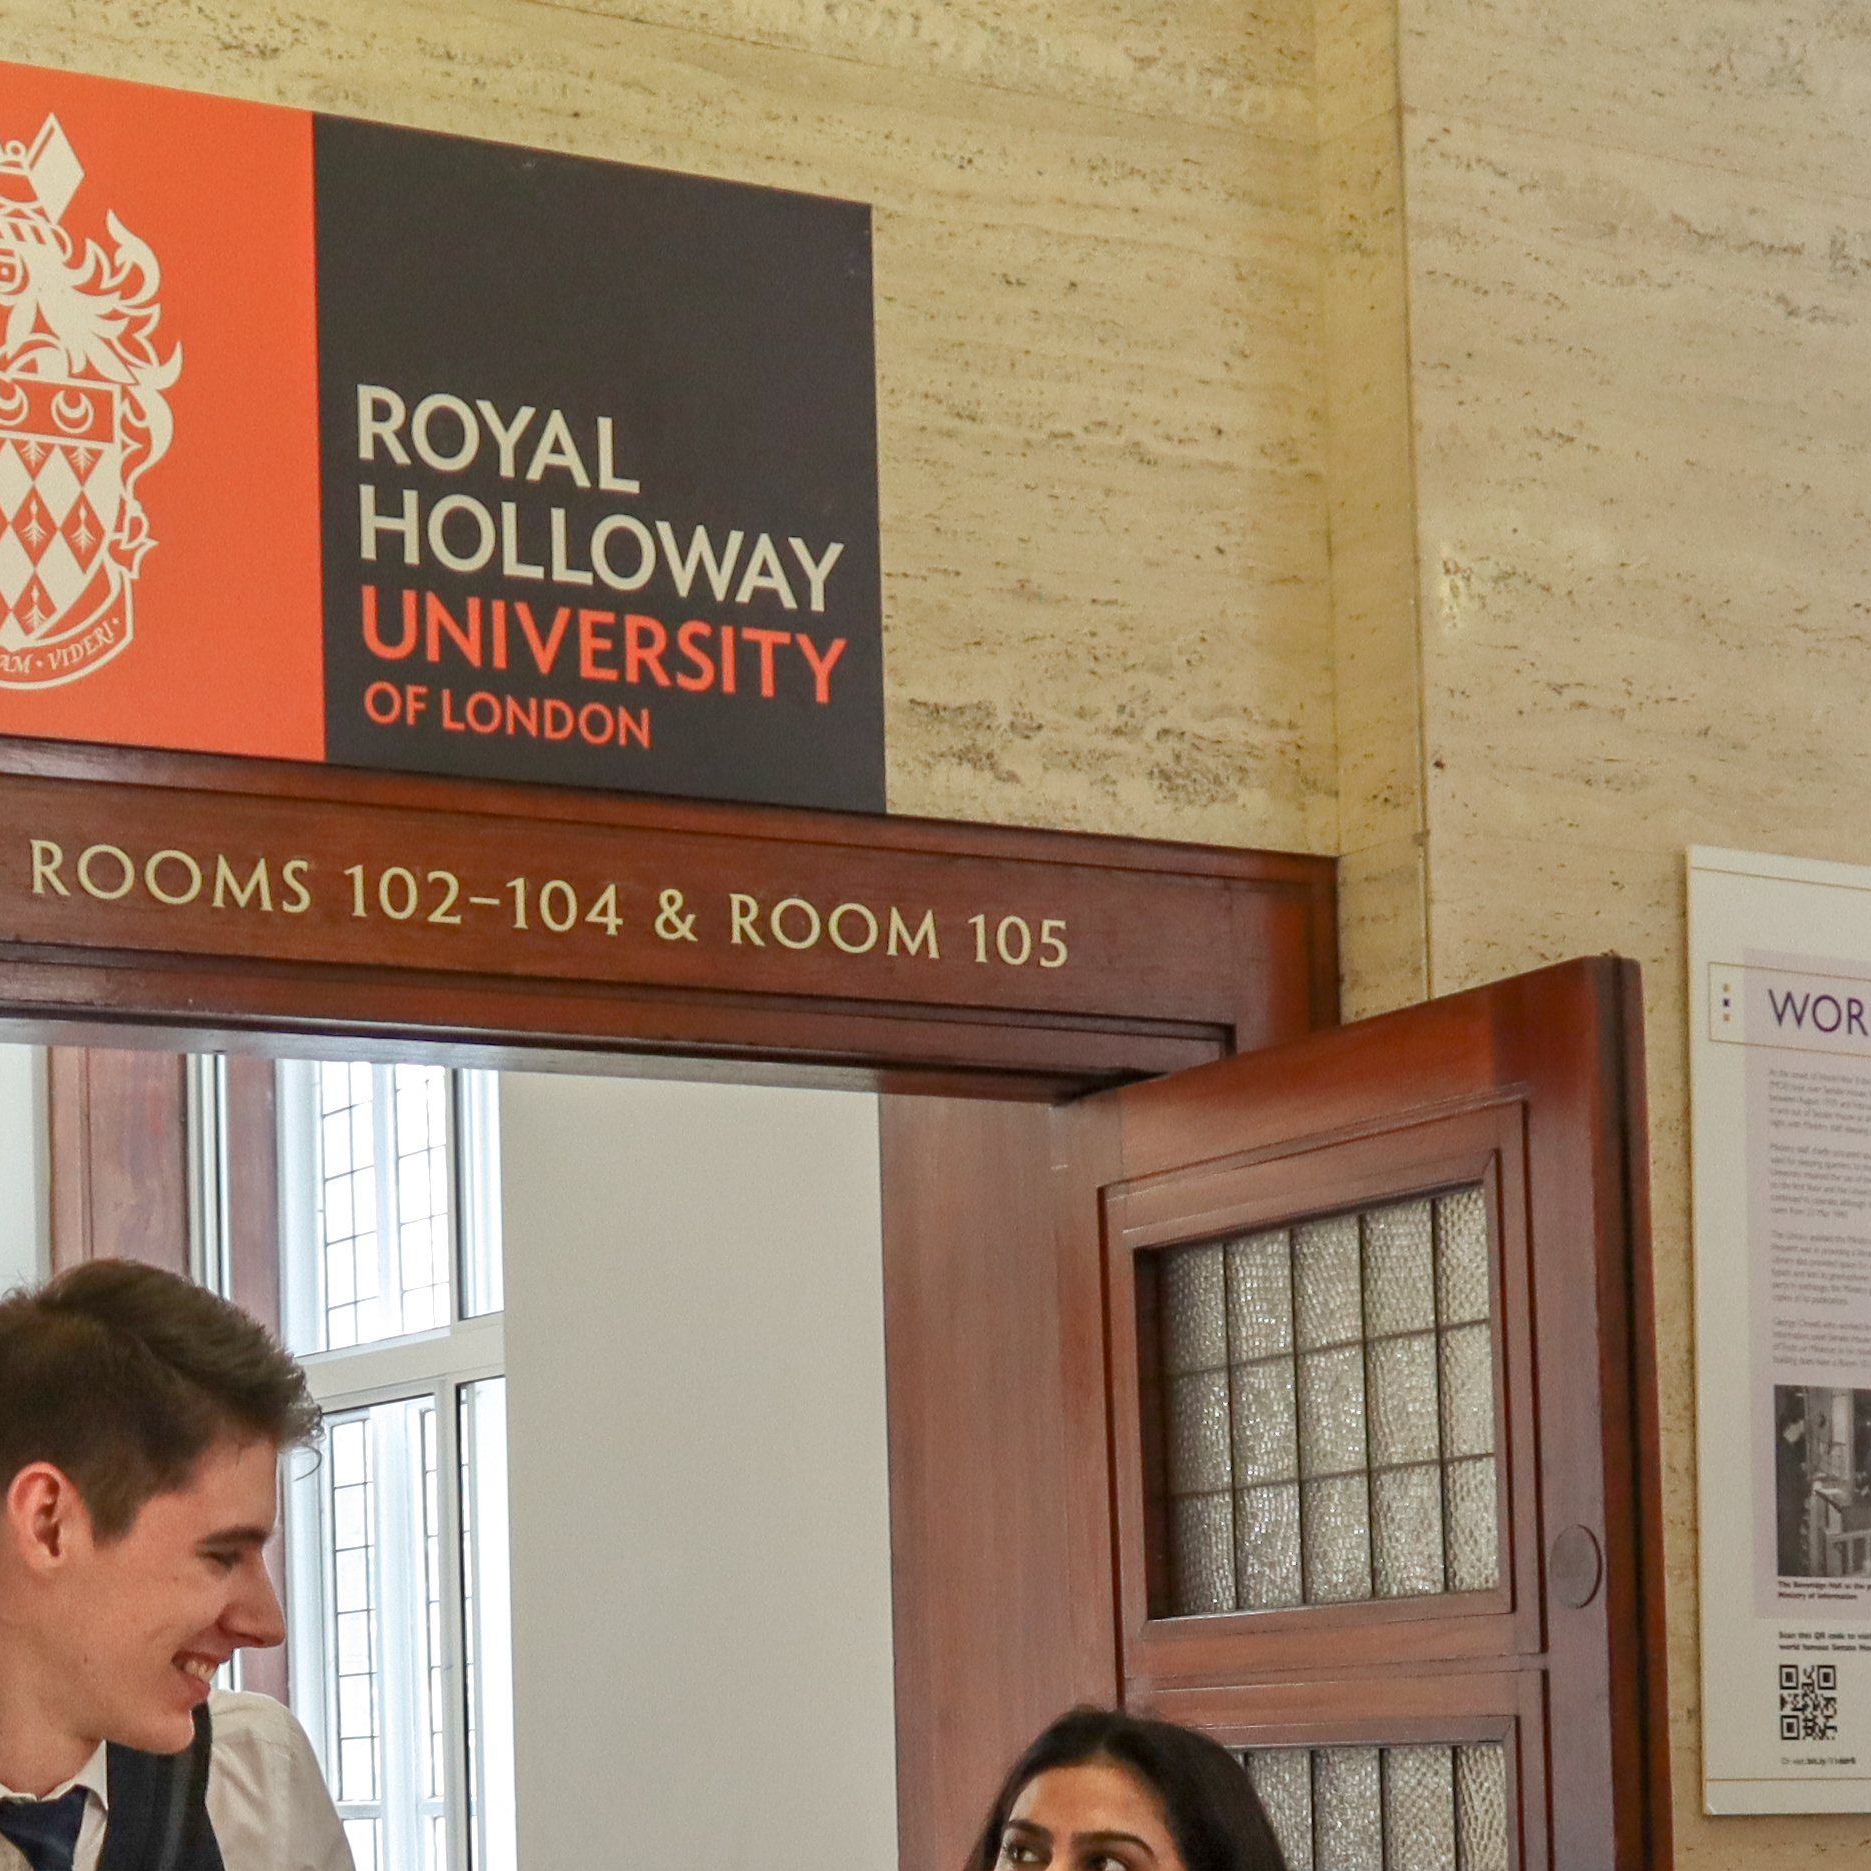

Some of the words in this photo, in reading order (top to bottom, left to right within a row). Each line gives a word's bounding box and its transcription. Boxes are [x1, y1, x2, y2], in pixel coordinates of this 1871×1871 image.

[358, 385, 640, 494] ROYAL
[360, 483, 844, 612] HOLLOWAY
[46, 620, 116, 671] VIDERI
[362, 586, 846, 704] UNIVERSITY
[364, 681, 429, 725] OF
[442, 690, 651, 748] LONDON
[31, 840, 311, 913] ROOMS
[344, 864, 625, 936] 102-104
[655, 888, 699, 942] &
[730, 893, 940, 960] ROOM
[969, 914, 1068, 968] 105
